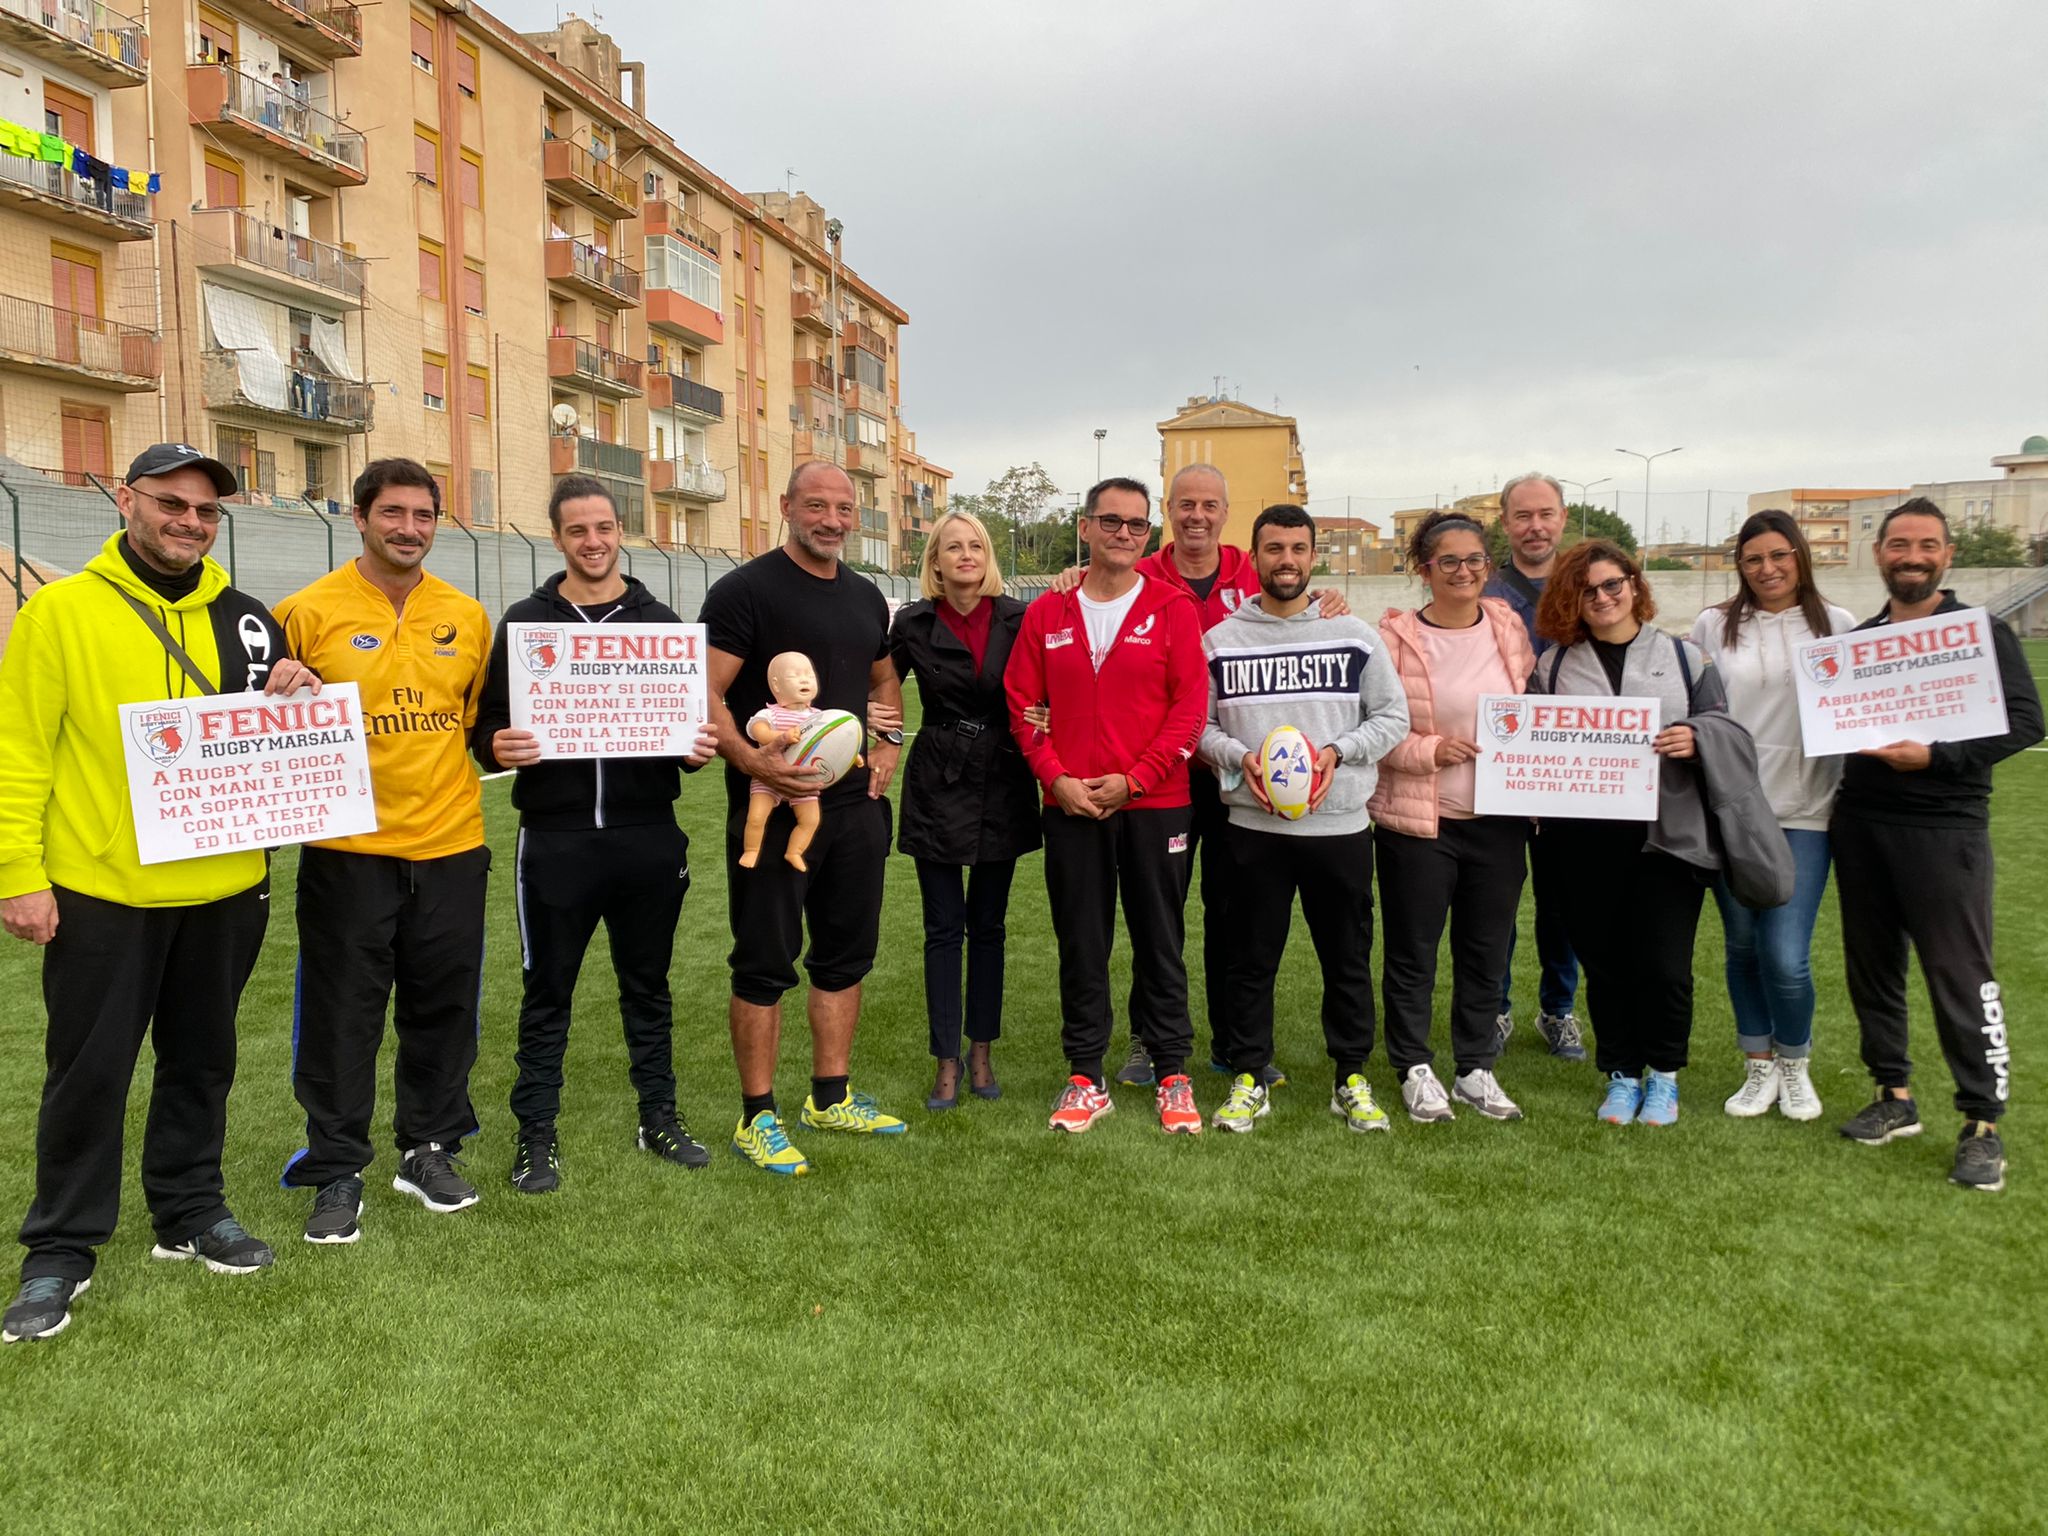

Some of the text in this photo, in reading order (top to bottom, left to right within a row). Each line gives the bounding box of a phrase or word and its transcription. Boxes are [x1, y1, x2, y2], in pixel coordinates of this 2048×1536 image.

[570, 634, 698, 661] FENICI
[1124, 635, 1152, 644] Marco
[1850, 620, 1981, 667] FENICI
[570, 663, 698, 675] RUGBY MARSALA
[1222, 653, 1352, 695] UNIVERSITY
[1853, 647, 1984, 680] RUGBY MARSALA
[528, 682, 542, 694] A
[618, 683, 635, 694] SI
[640, 682, 689, 694] GIOCA
[1903, 684, 1914, 694] A
[1920, 674, 1978, 691] CUORE
[392, 687, 424, 708] Fly
[533, 698, 567, 710] CON
[574, 698, 620, 710] MANI
[627, 698, 636, 708] E
[642, 698, 685, 708] PIEDI
[1834, 690, 1963, 718] LA SALUTE DEI
[198, 698, 352, 741] FENICI
[531, 712, 688, 724] MA SOPRATTUTTO
[1532, 706, 1651, 731] FENICI
[1835, 704, 1967, 731] NOSTRI ATLETI
[201, 728, 354, 758] RUGBY MARSALA
[550, 726, 671, 738] CON LA TESTA
[1531, 730, 1650, 745] RUGBY MARSALA
[556, 738, 665, 753] ED IL CUORE!
[153, 771, 170, 786] A
[262, 760, 280, 773] SI
[288, 752, 346, 770] GIOCA
[1506, 768, 1624, 781] LA SALUTE DEI
[1572, 756, 1582, 766] A
[1588, 757, 1640, 769] CUORE
[160, 786, 201, 803] CON
[210, 779, 266, 796] MANI
[276, 776, 284, 788] E
[292, 770, 343, 786] PIEDI
[1505, 780, 1624, 794] NOSTRI ATLETI
[159, 785, 348, 820] MA SOPRATTUTTO
[184, 802, 330, 834] CON LA TESTA
[194, 818, 325, 850] ED IL CUORE!
[1980, 980, 2010, 1100] adidas
